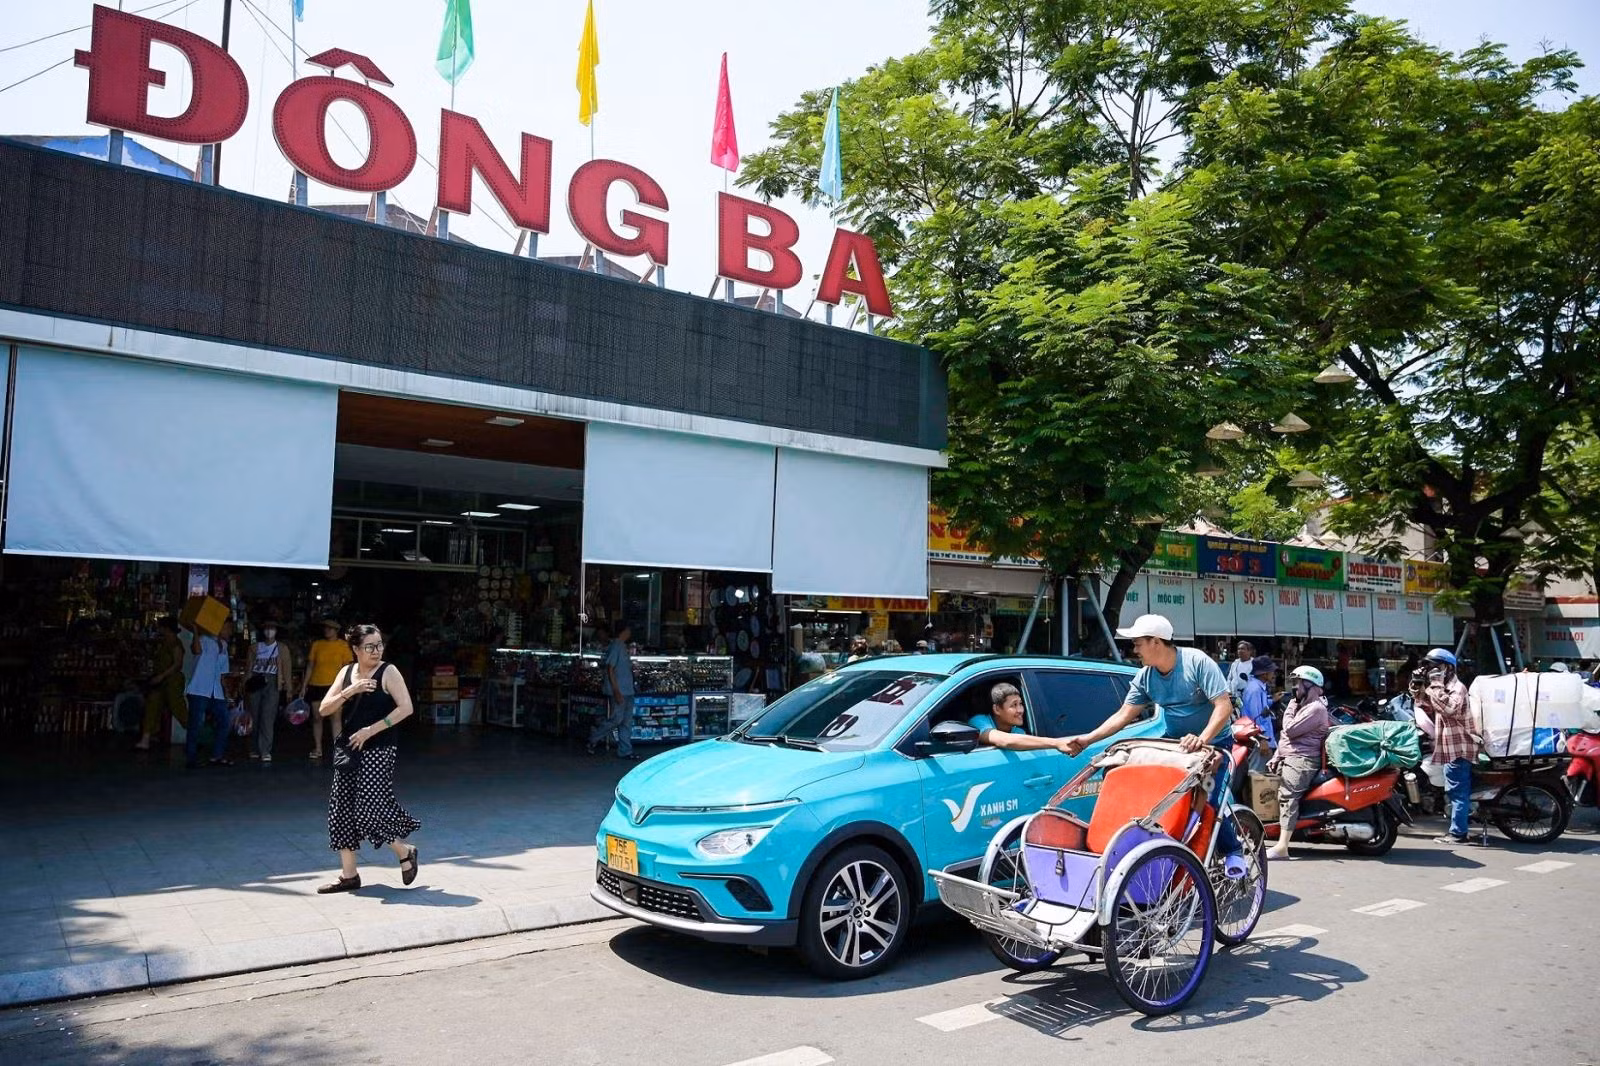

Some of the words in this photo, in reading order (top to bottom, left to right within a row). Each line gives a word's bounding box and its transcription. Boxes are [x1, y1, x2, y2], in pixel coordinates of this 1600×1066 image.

[73, 4, 670, 268] ĐÔNG
[717, 191, 894, 318] BA
[1349, 562, 1379, 577] MINH
[1203, 582, 1217, 604] SỐ
[1218, 588, 1225, 605] 5
[1243, 583, 1256, 605] SỐ
[1258, 588, 1265, 606] 5
[1352, 783, 1381, 793] LEAD
[980, 800, 1005, 817] XANH
[1006, 798, 1019, 812] SM
[614, 838, 629, 855] 75E
